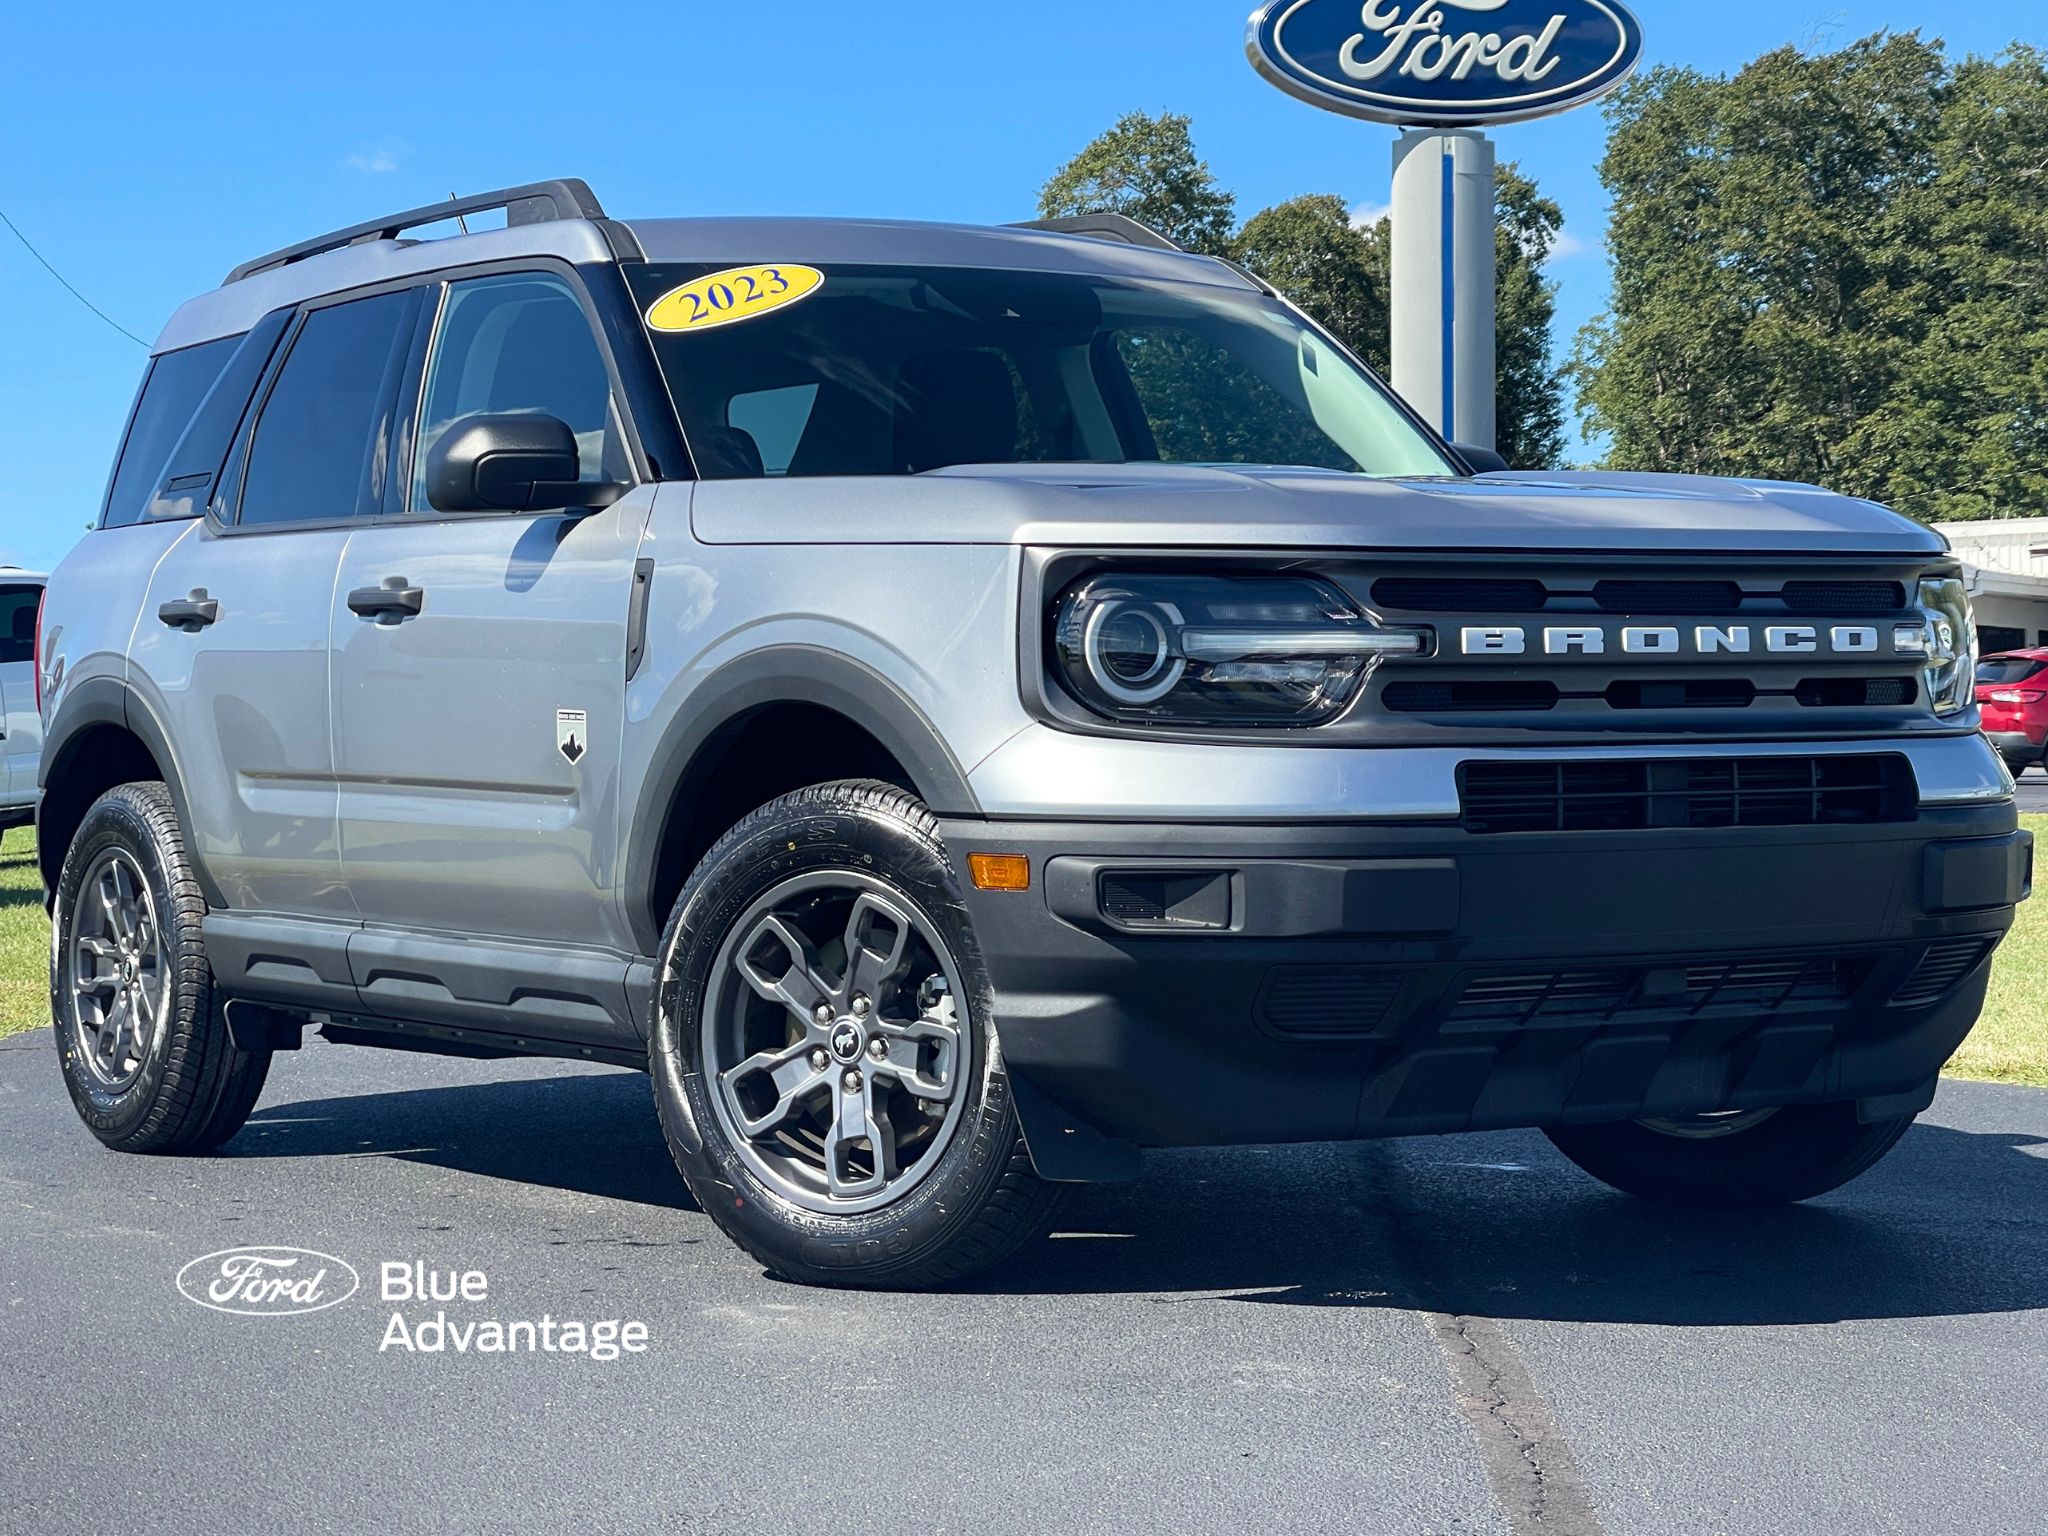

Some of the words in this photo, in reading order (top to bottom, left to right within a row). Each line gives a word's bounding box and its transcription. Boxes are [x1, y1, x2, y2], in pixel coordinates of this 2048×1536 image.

[1339, 0, 1566, 82] Ford
[679, 268, 789, 323] 2023
[1461, 627, 1878, 654] BRONCO
